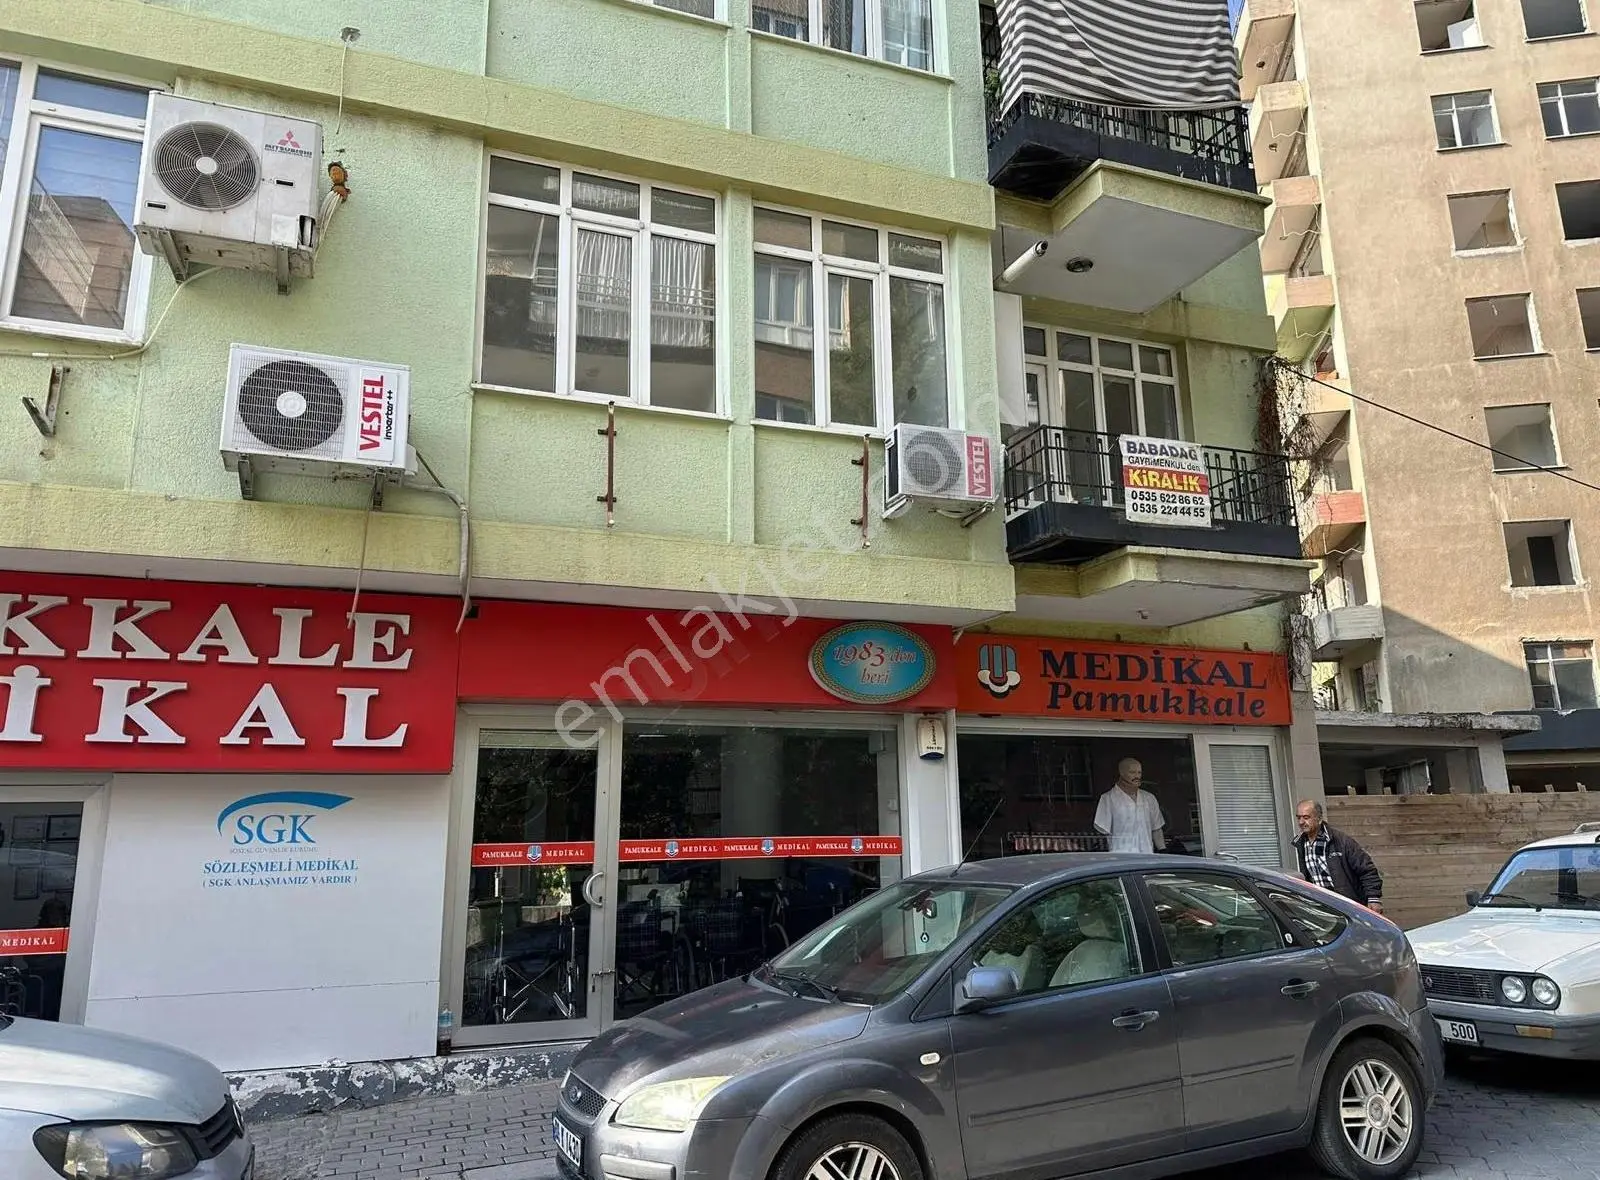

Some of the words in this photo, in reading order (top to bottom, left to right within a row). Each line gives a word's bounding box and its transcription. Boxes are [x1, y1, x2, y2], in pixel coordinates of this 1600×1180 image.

[359, 375, 384, 451] VESTEL
[972, 438, 986, 495] VESTEL
[860, 668, 890, 684] beri
[1038, 649, 1268, 689] MEDİKAL
[1046, 681, 1265, 718] Pamukkale
[233, 814, 316, 845] SGK
[482, 850, 523, 858] PAMUKKALE
[545, 848, 585, 857] MEDİKAL
[624, 846, 662, 854] PAMUKKALE
[682, 844, 718, 852] MEDİKAL
[777, 842, 810, 850] MEDİKAL
[203, 858, 295, 875] SÖZLEŞMELİ
[296, 858, 358, 871] MEDİKAL
[235, 876, 308, 887] ANLAŞMAMIZ
[2, 936, 55, 947] MEDİKAL
[1450, 1022, 1475, 1040] 500
